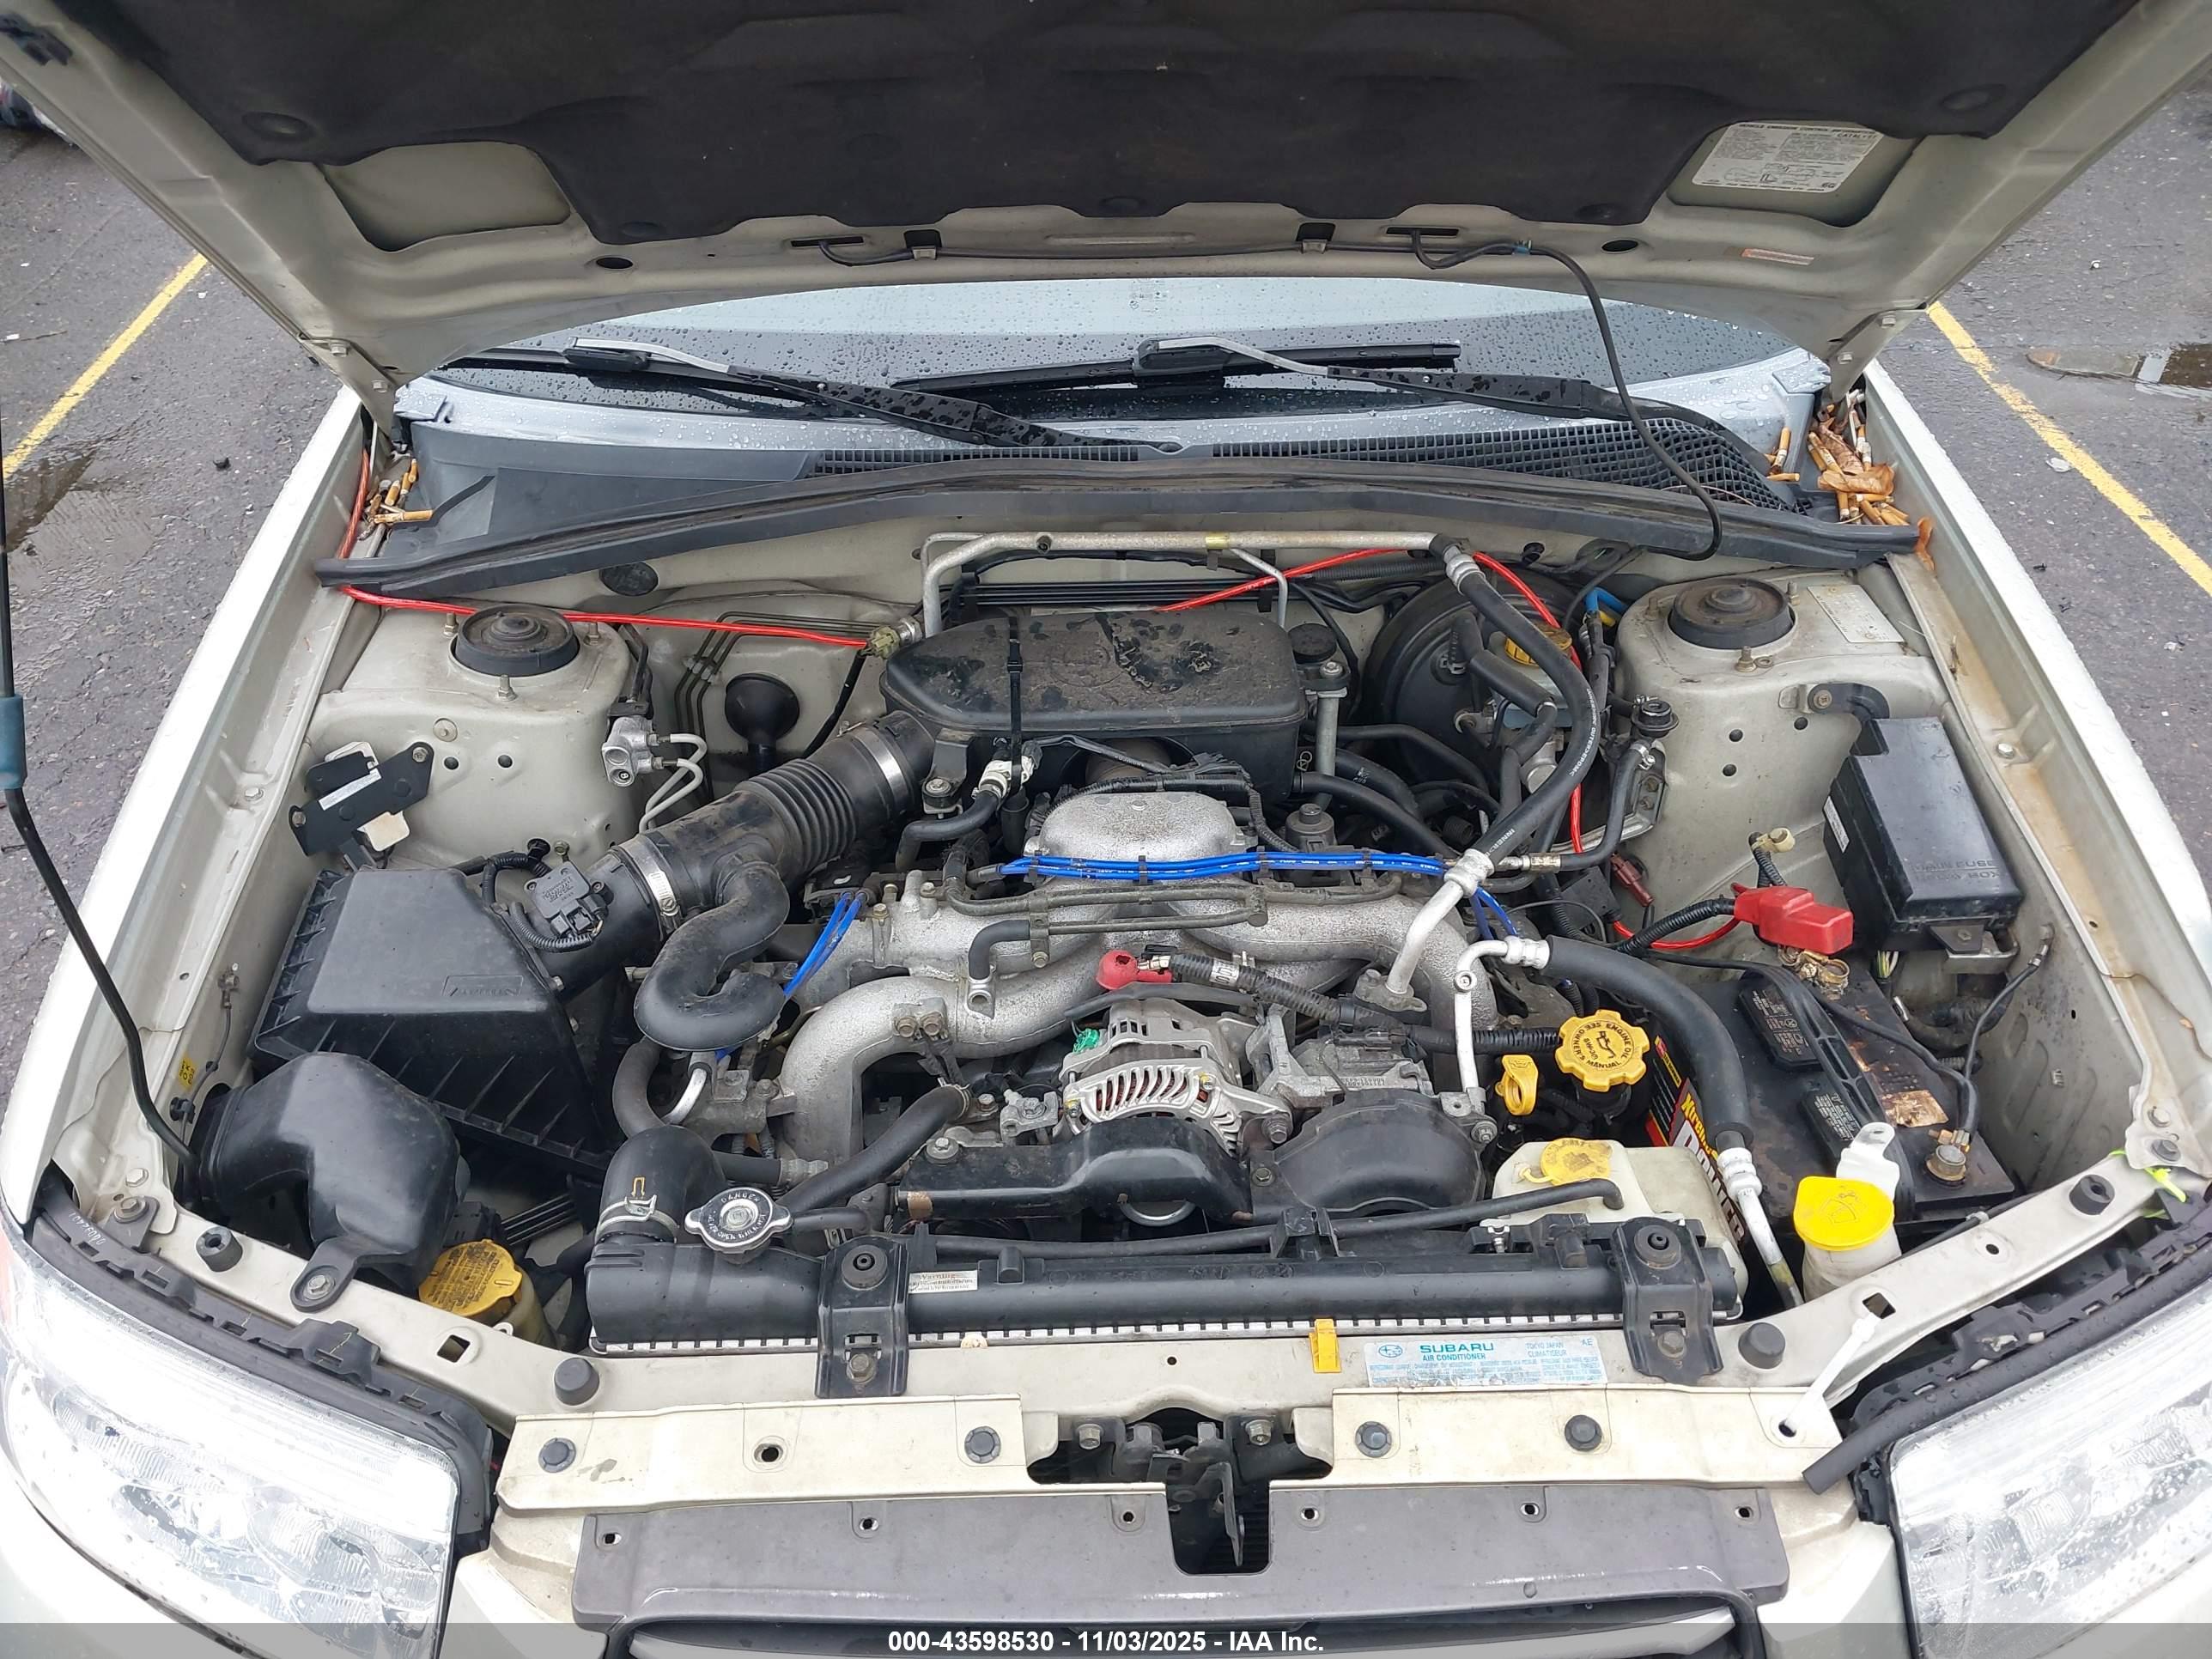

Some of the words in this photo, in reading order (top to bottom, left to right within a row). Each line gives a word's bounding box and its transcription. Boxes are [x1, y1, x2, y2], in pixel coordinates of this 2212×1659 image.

[1606, 1023, 1632, 1046] ENGINE
[1621, 1048, 1632, 1059] OIL
[1586, 1060, 1622, 1069] MANUAL
[1419, 1342, 1494, 1353] SUBARU
[1437, 1352, 1486, 1361] CONDITIONER
